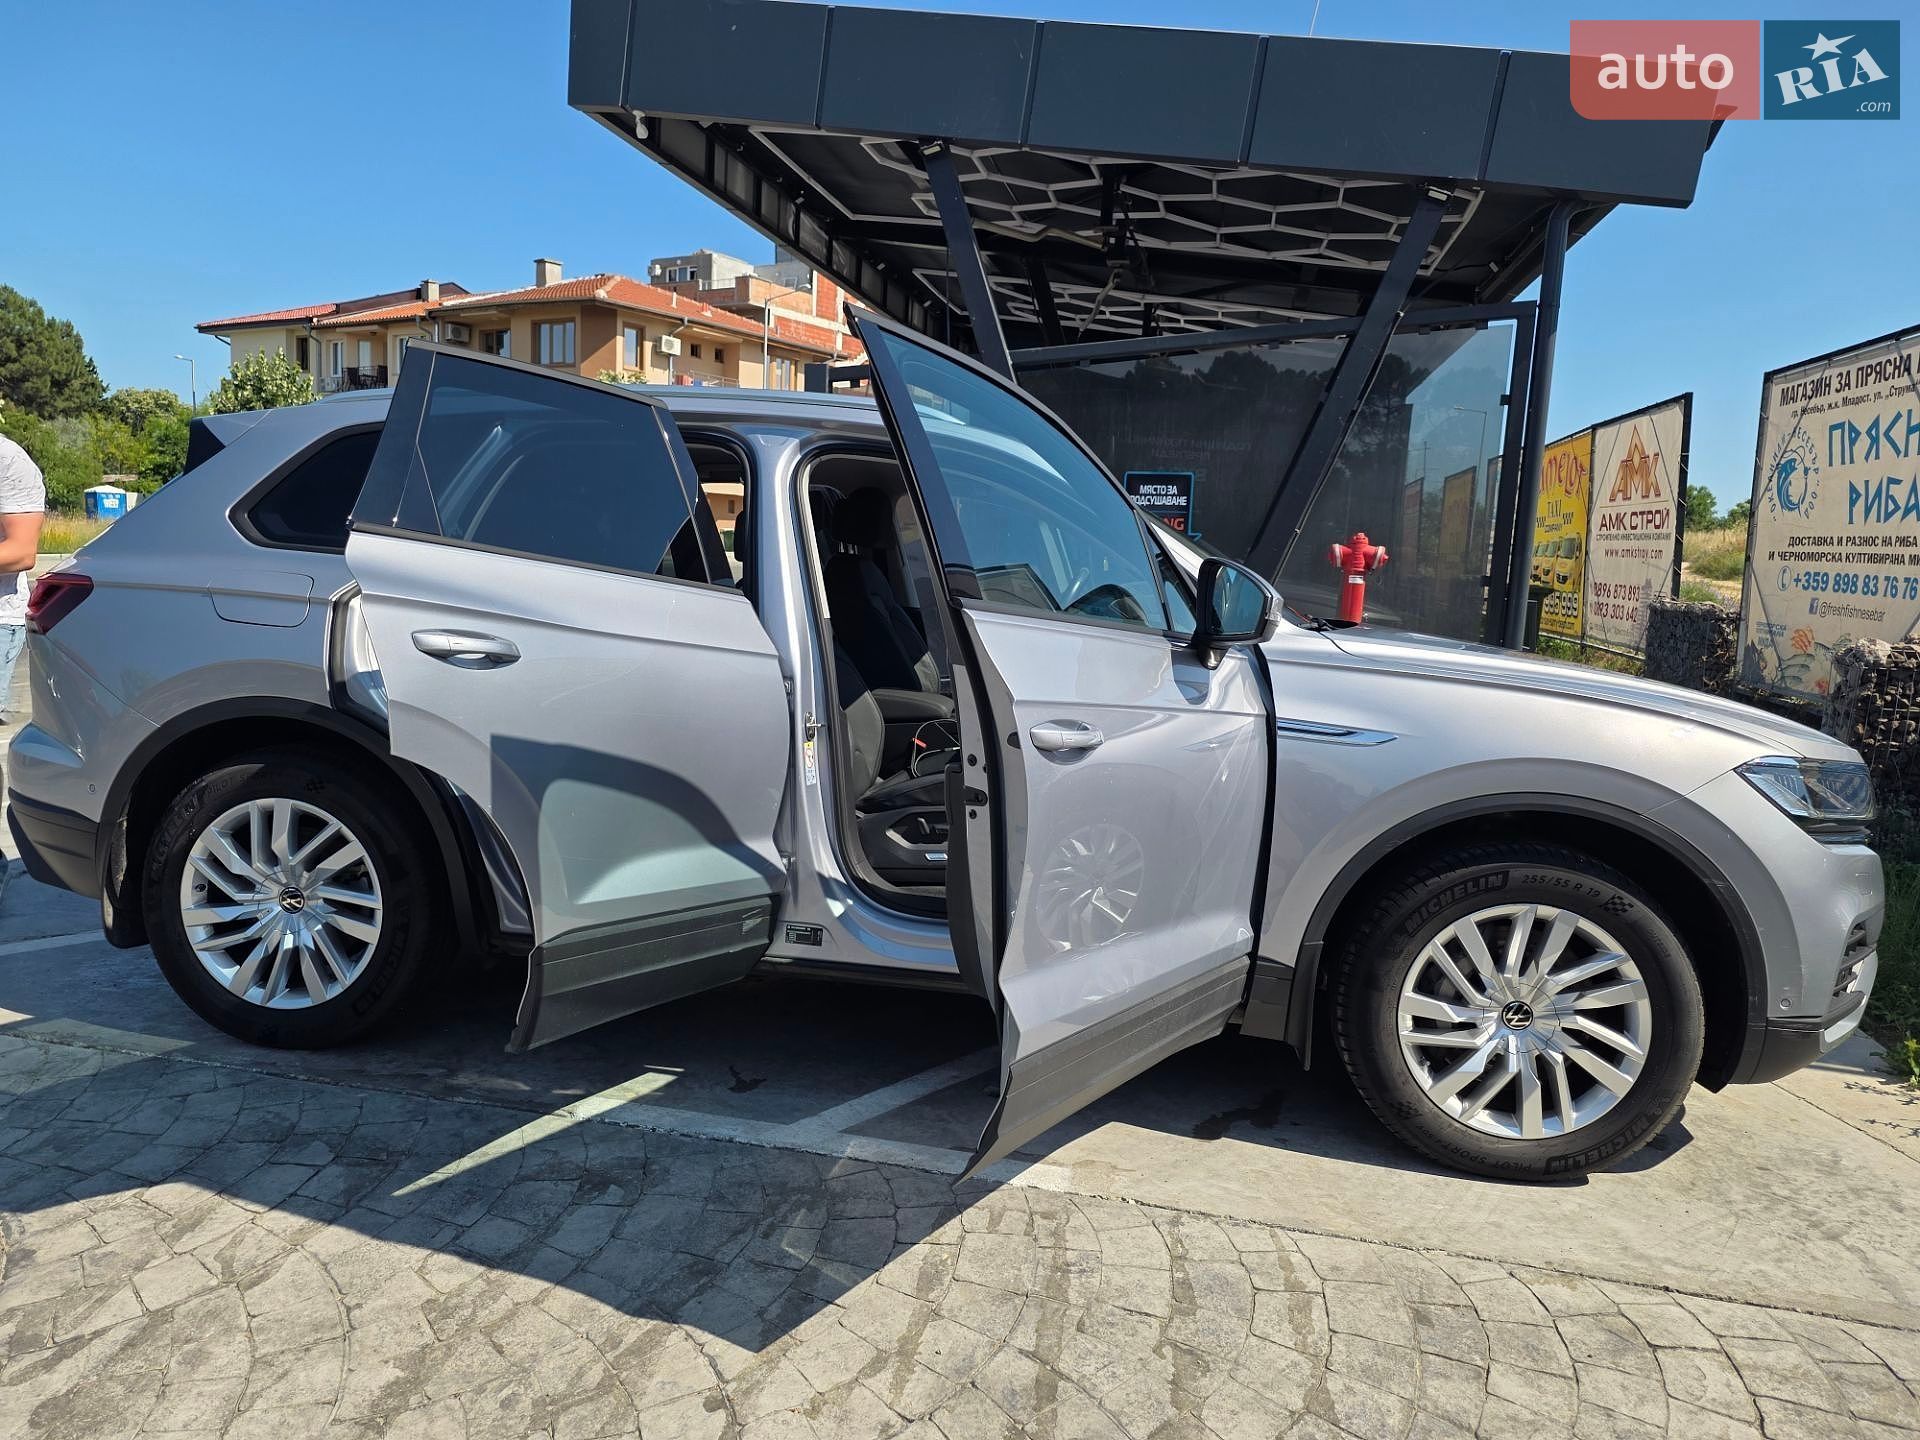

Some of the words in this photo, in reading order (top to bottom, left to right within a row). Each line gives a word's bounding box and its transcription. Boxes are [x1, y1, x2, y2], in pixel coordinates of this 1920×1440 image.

[1779, 374, 1832, 407] МАГАЗИН
[1835, 370, 1851, 393] ЗА
[1856, 353, 1912, 389] ПРЯСНА
[1139, 485, 1167, 495] МЯСТО
[1167, 485, 1178, 495] ЗА
[1848, 472, 1920, 526] РИБА
[1547, 500, 1562, 518] TAXI
[1599, 512, 1627, 532] АМК
[1630, 507, 1670, 530] СТРОЙ
[1787, 535, 1834, 548] ДОСТАВКА
[1837, 536, 1843, 547] И
[1845, 536, 1880, 548] РАЗНОС
[1881, 536, 1893, 548] НА
[1894, 536, 1918, 548] РИБА
[1768, 551, 1775, 561] И
[1777, 552, 1843, 563] ЧЕРНОМОРСКА
[1845, 553, 1906, 566] КУЛТИВИРАНА
[1613, 584, 1627, 600] 873
[1628, 586, 1641, 602] 893
[1793, 571, 1830, 592] +359
[1832, 572, 1859, 595] 898
[1862, 574, 1879, 597] 83
[1883, 575, 1899, 599] 76
[1902, 577, 1918, 600] 76
[1610, 604, 1625, 620] 303
[1625, 606, 1638, 623] 642
[1404, 871, 1509, 936] MICHELIN
